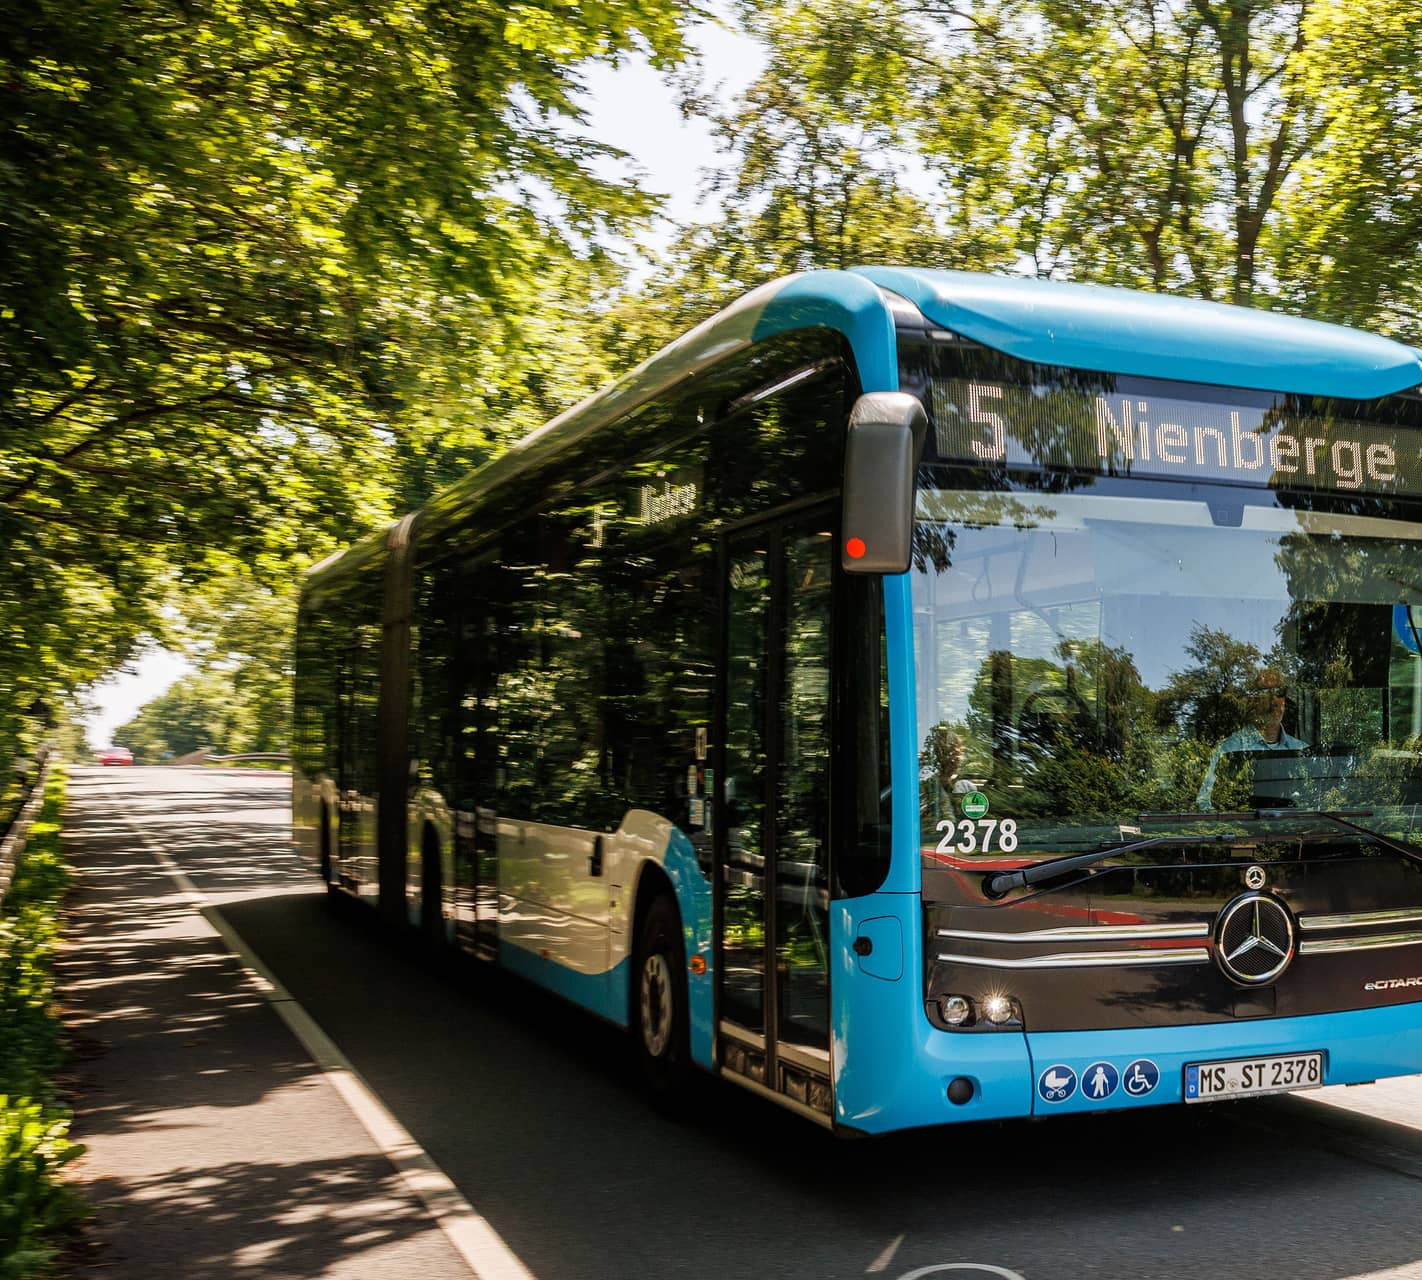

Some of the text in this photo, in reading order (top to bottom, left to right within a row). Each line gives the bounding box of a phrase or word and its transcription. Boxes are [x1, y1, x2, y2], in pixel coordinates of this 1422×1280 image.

[968, 383, 1396, 489] 5 Nienberge
[935, 818, 1018, 854] 2378
[1200, 1058, 1319, 1094] MS ST 2378
